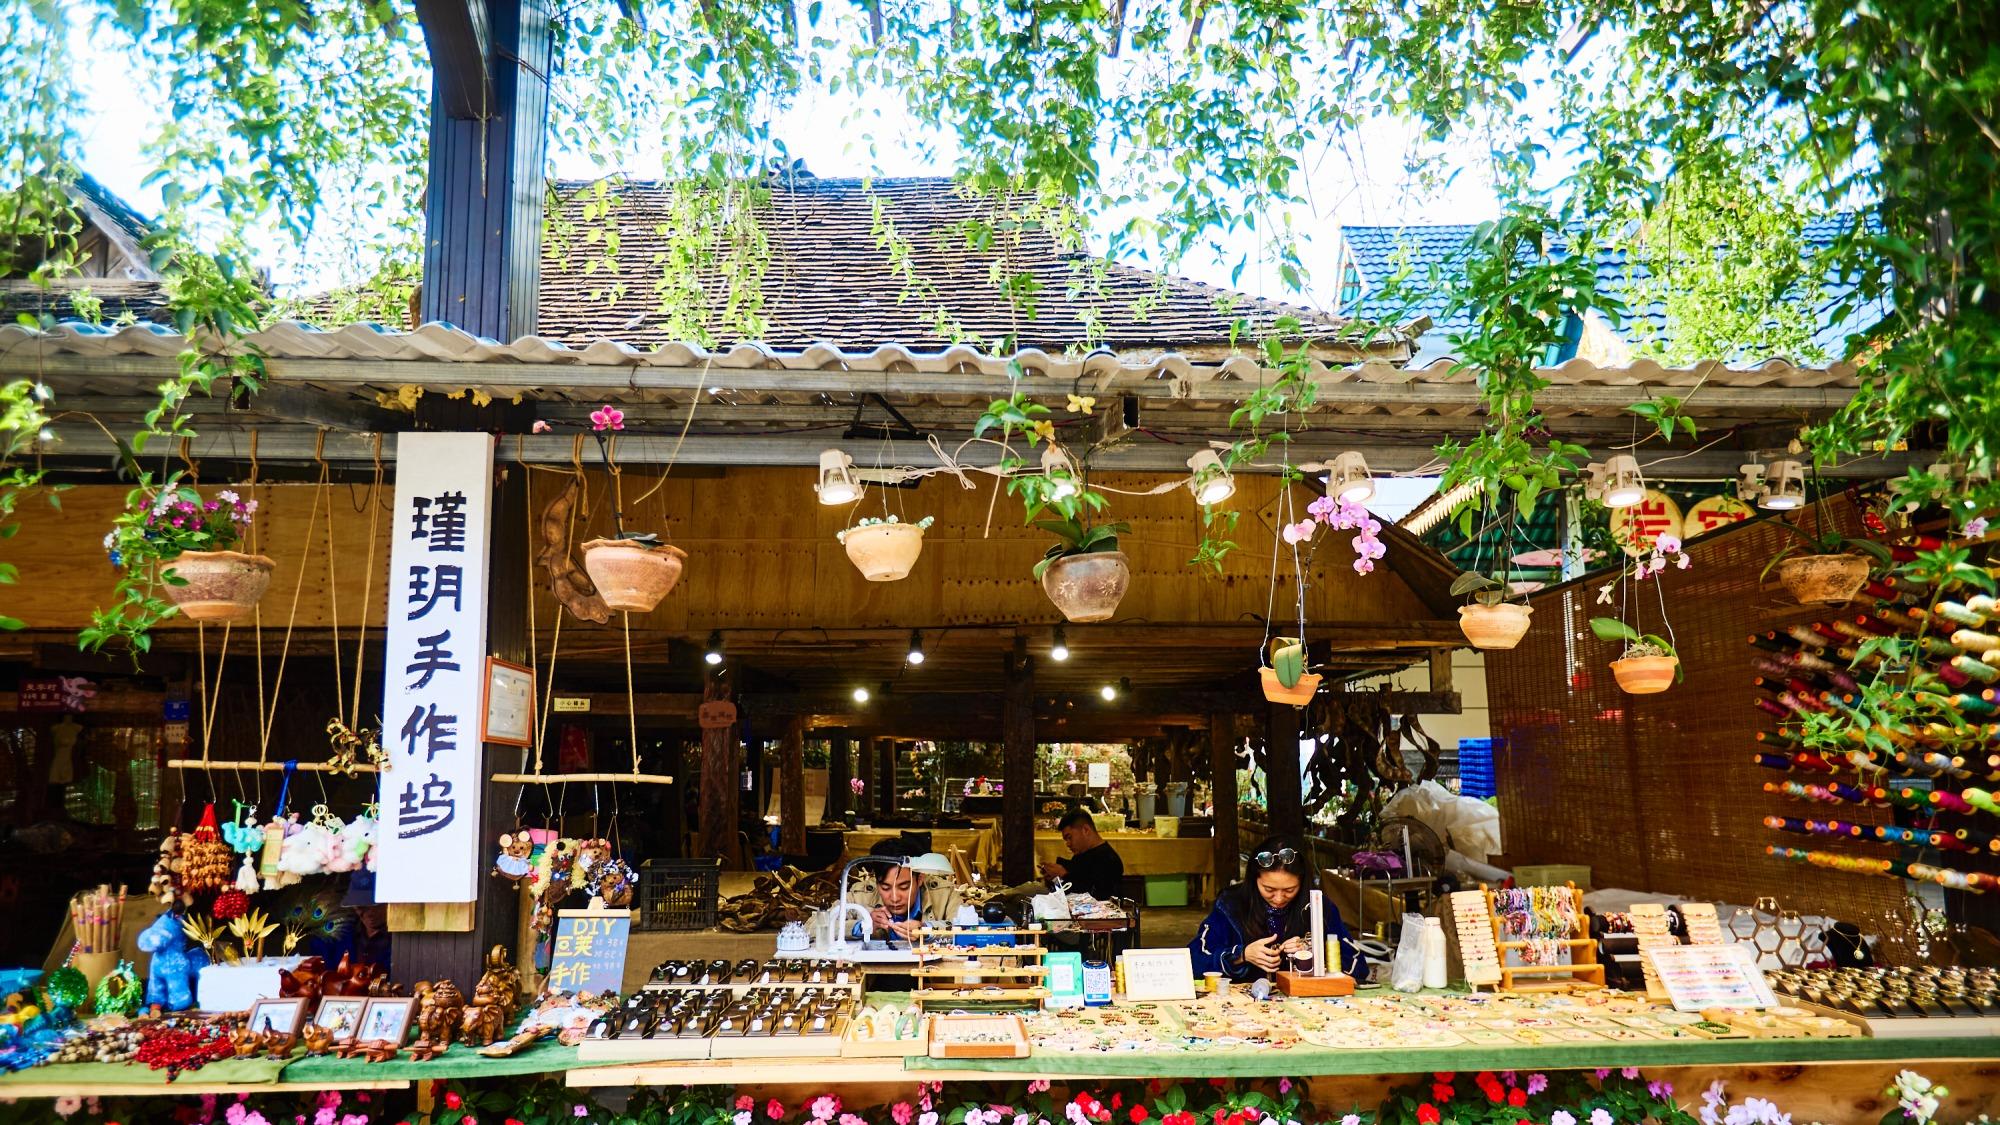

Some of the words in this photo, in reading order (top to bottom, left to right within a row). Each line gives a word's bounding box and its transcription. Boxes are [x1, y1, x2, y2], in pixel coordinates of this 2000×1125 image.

[397, 490, 467, 839] 瑾玥手作坞
[573, 918, 617, 936] DIY
[549, 961, 592, 986] 手作
